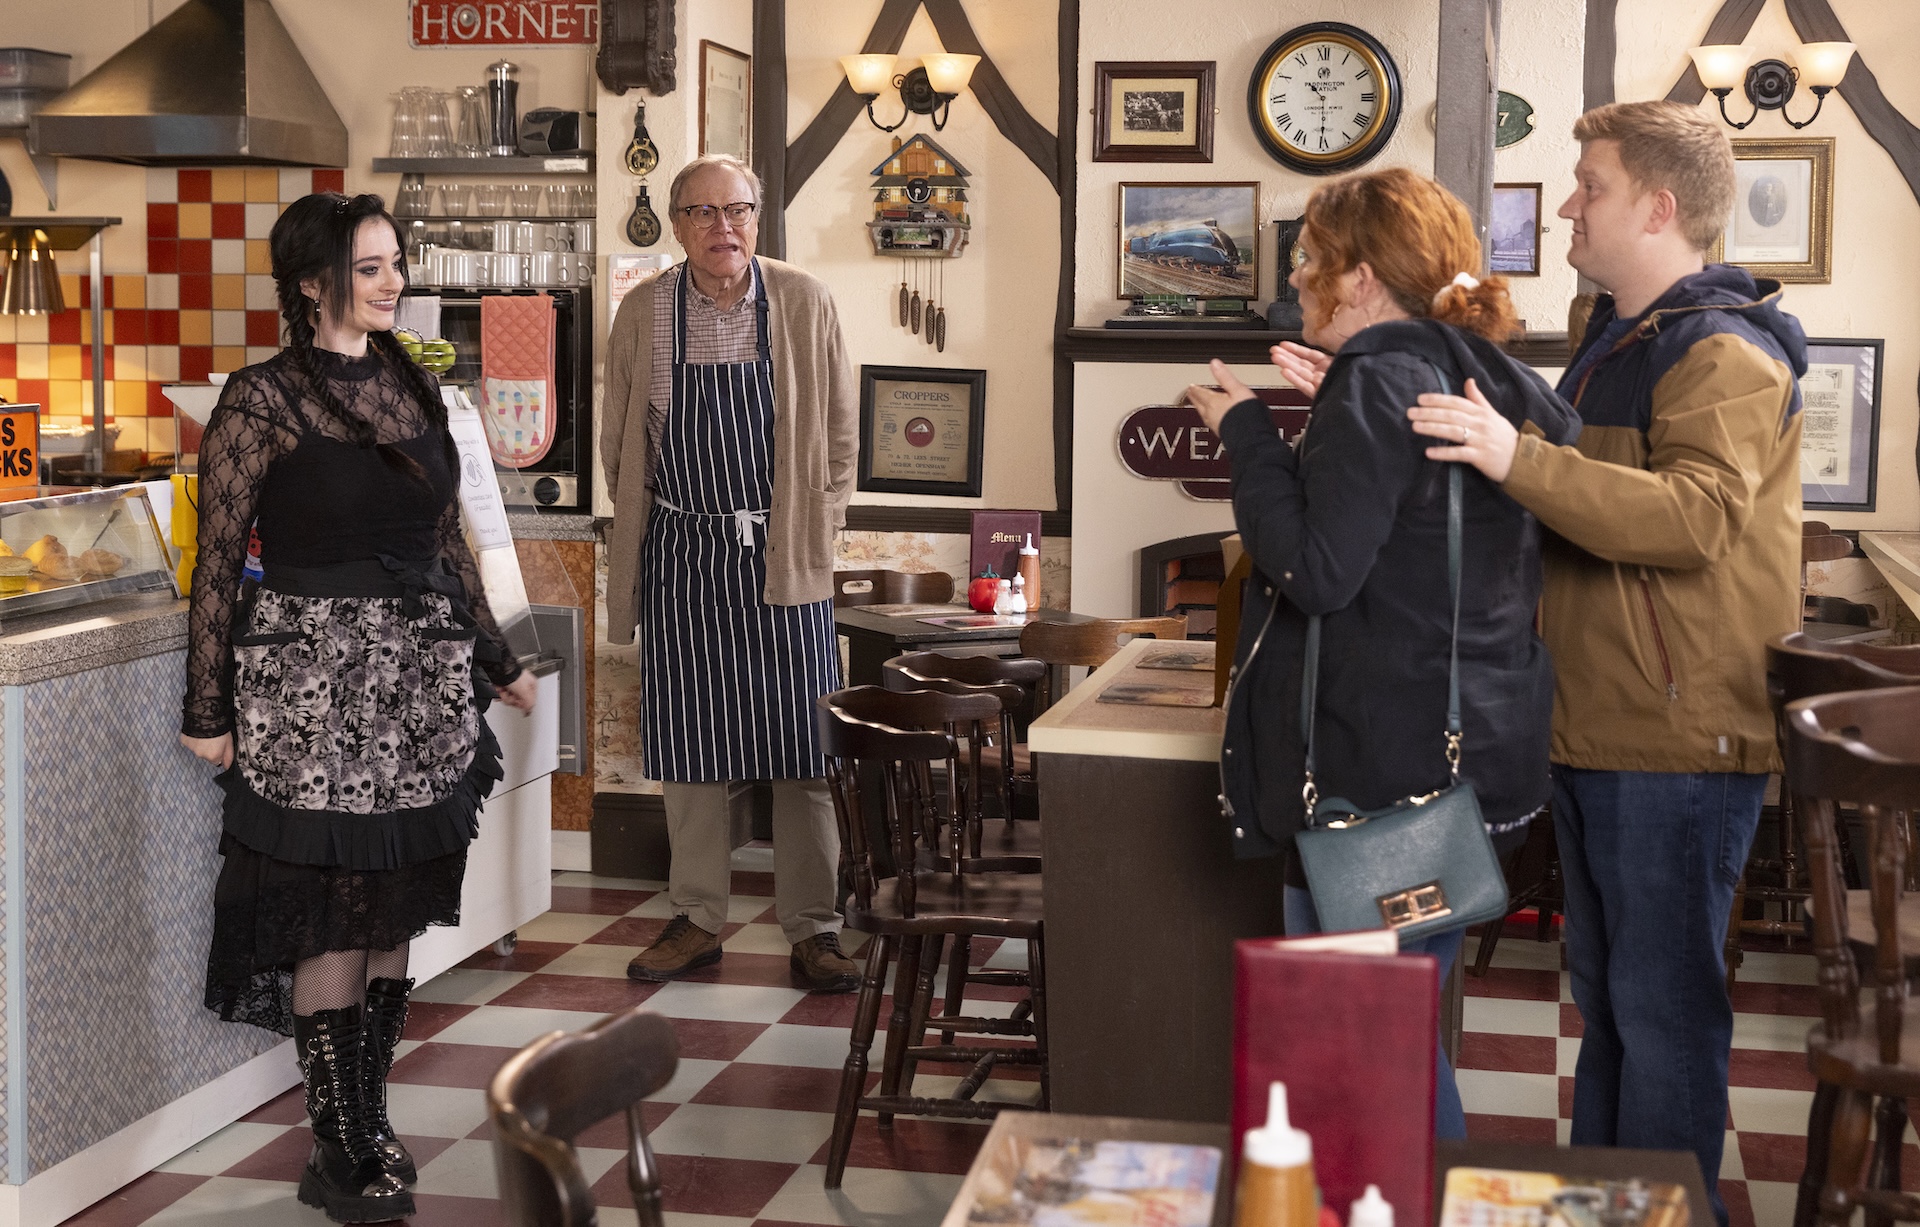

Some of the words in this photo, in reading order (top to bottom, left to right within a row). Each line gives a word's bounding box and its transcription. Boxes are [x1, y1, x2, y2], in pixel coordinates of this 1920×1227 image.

[894, 390, 950, 402] CROPPERS
[0, 448, 32, 477] KS
[990, 531, 1022, 544] Menu
